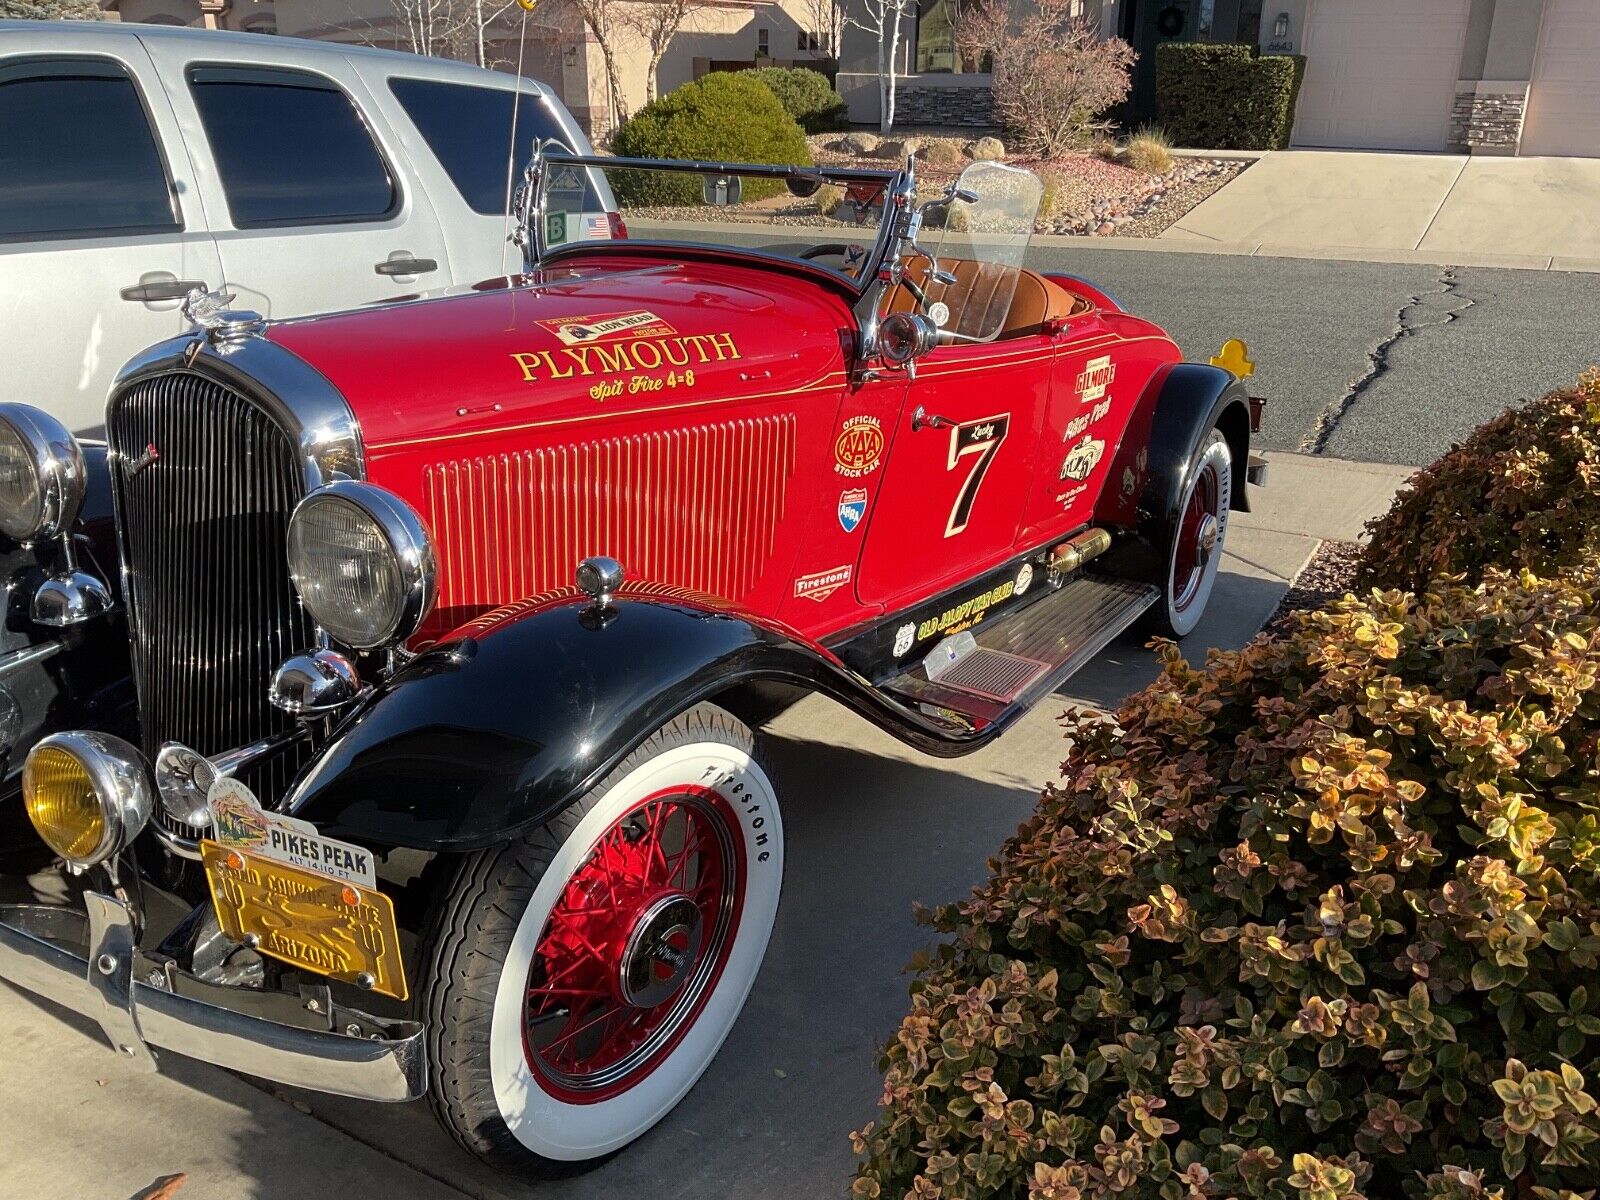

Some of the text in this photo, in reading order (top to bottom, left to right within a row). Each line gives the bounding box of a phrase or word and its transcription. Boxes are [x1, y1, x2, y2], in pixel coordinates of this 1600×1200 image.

[550, 216, 563, 240] B
[595, 314, 653, 333] LION HEAD
[509, 331, 742, 381] PLYMOUTH
[589, 379, 624, 402] Spit
[628, 374, 664, 395] Fire
[1076, 364, 1116, 393] GILMORE
[842, 415, 881, 430] OFFICIAL
[971, 423, 995, 441] Lucky
[834, 458, 881, 478] STOCK CAR
[943, 411, 1011, 539] 7
[797, 570, 849, 593] Firestone
[917, 616, 940, 641] OLD
[937, 599, 975, 631] JALOPY
[897, 636, 910, 652] 66
[701, 765, 771, 863] Firestone
[271, 829, 368, 875] PIKES PEAK
[268, 929, 349, 973] ARIZONA
